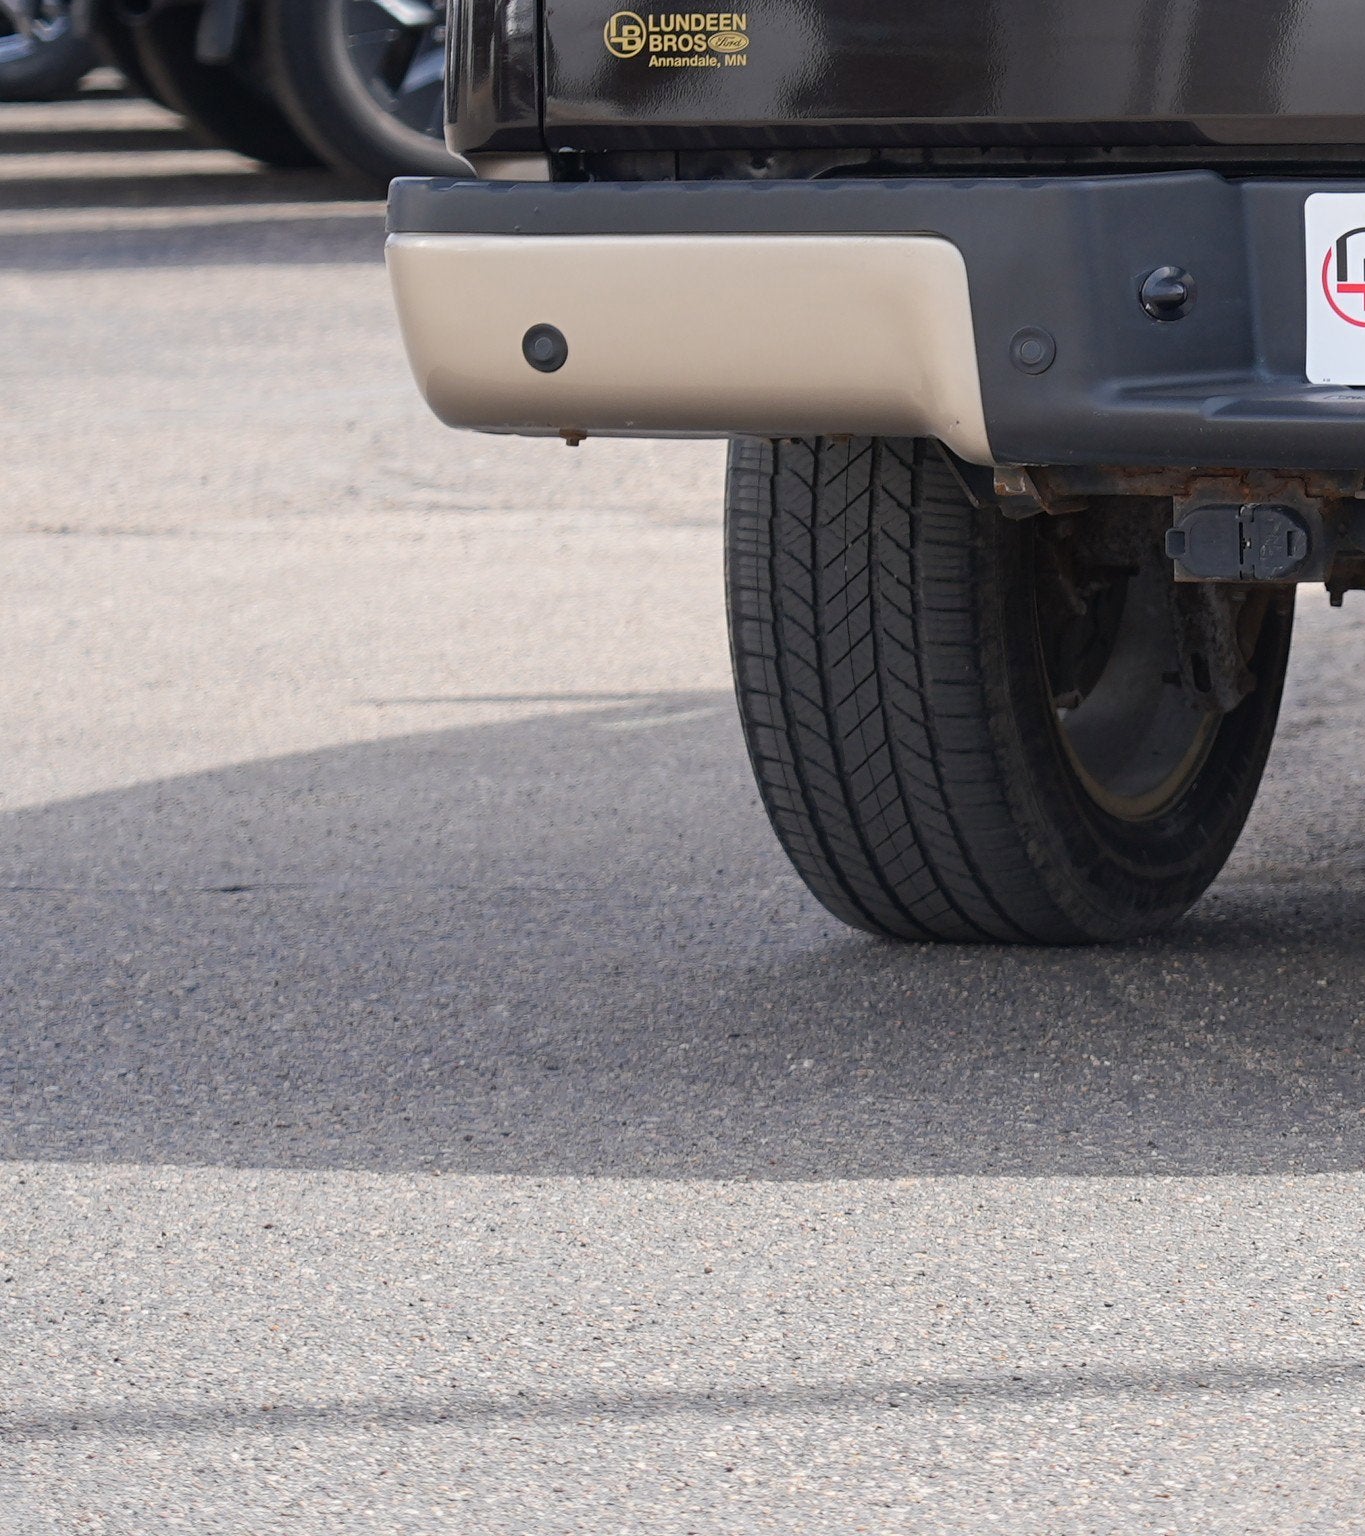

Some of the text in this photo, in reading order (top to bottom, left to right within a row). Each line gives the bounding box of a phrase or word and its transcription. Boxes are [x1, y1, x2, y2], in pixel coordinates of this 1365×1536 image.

[649, 13, 747, 32] LUNDEEN
[649, 34, 742, 52] BROS Ford
[649, 55, 747, 68] Annandale, MN
